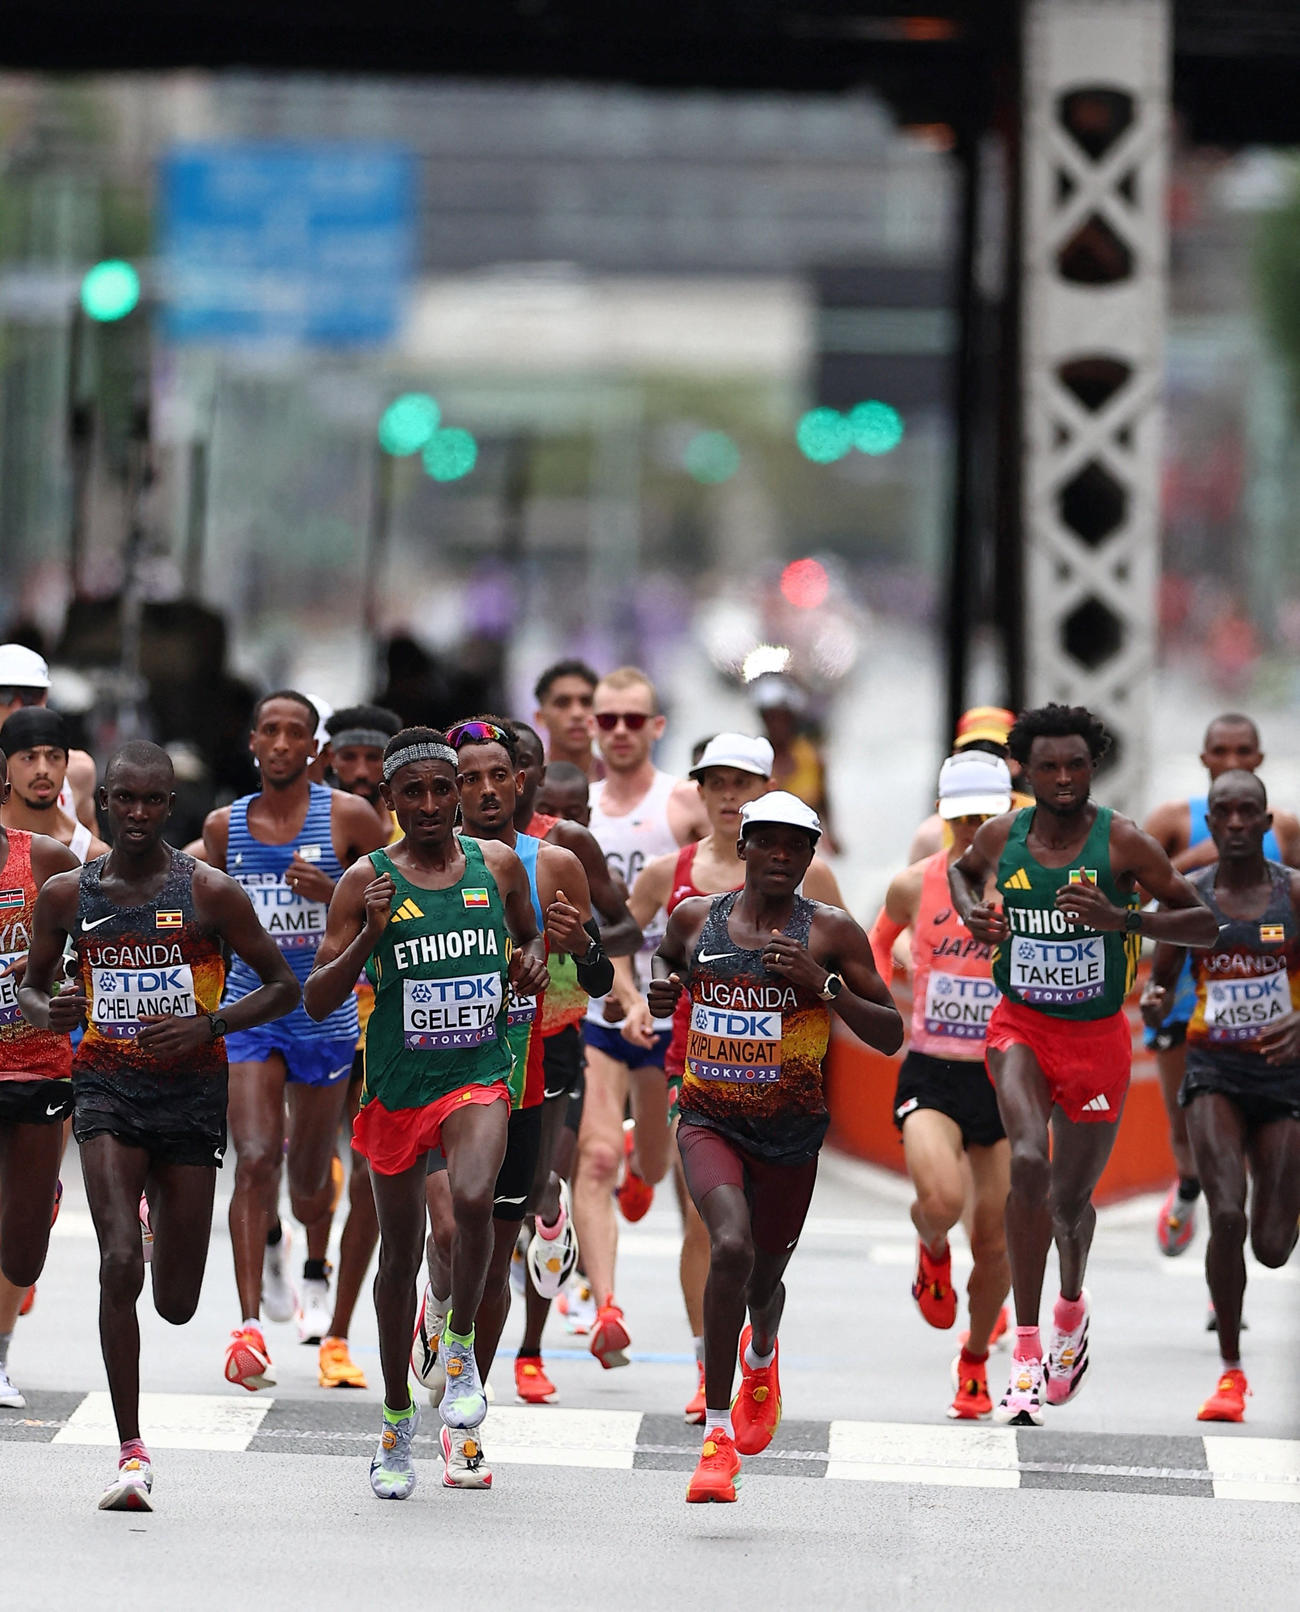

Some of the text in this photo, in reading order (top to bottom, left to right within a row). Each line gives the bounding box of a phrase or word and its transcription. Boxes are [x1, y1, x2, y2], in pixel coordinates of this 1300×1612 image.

[87, 944, 183, 966] UGANDA
[394, 928, 498, 970] ETHIOPIA
[1036, 941, 1097, 963] TDK
[1017, 962, 1099, 986] TAKELE
[1203, 953, 1287, 973] UGANDA
[116, 969, 184, 992] TDK
[431, 976, 497, 1002] TDK
[1226, 976, 1282, 1002] TDK
[97, 993, 191, 1020] CHELANGAT
[700, 981, 798, 1008] UGANDA
[411, 1002, 495, 1030] GELETA
[709, 1011, 772, 1037] TDK
[1214, 1000, 1283, 1025] KISSA
[690, 1036, 777, 1063] KIPLANGAT
